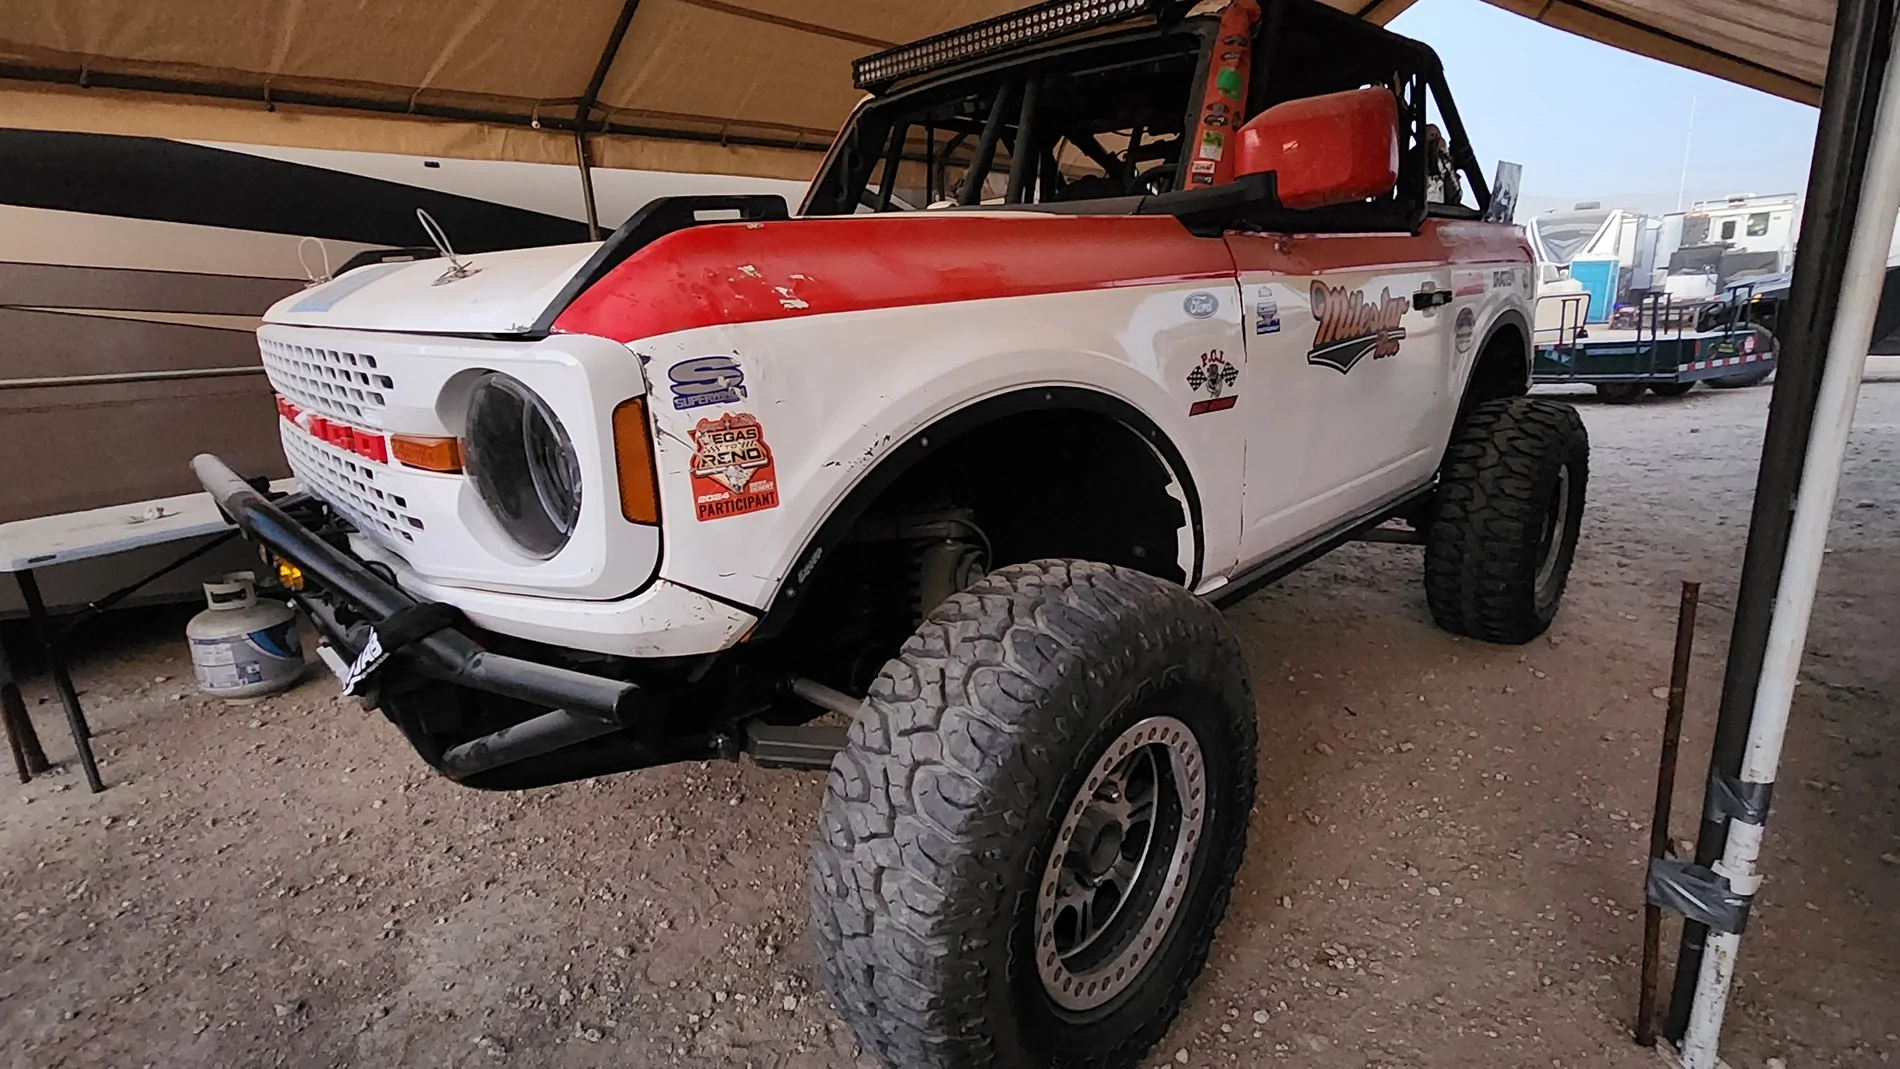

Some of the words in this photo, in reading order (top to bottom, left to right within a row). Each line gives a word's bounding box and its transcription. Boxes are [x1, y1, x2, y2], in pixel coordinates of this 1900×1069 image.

[1190, 296, 1213, 314] Ford
[674, 386, 747, 409] SUPERWIN
[701, 448, 761, 467] RENO
[698, 492, 775, 518] PARTICIPANT
